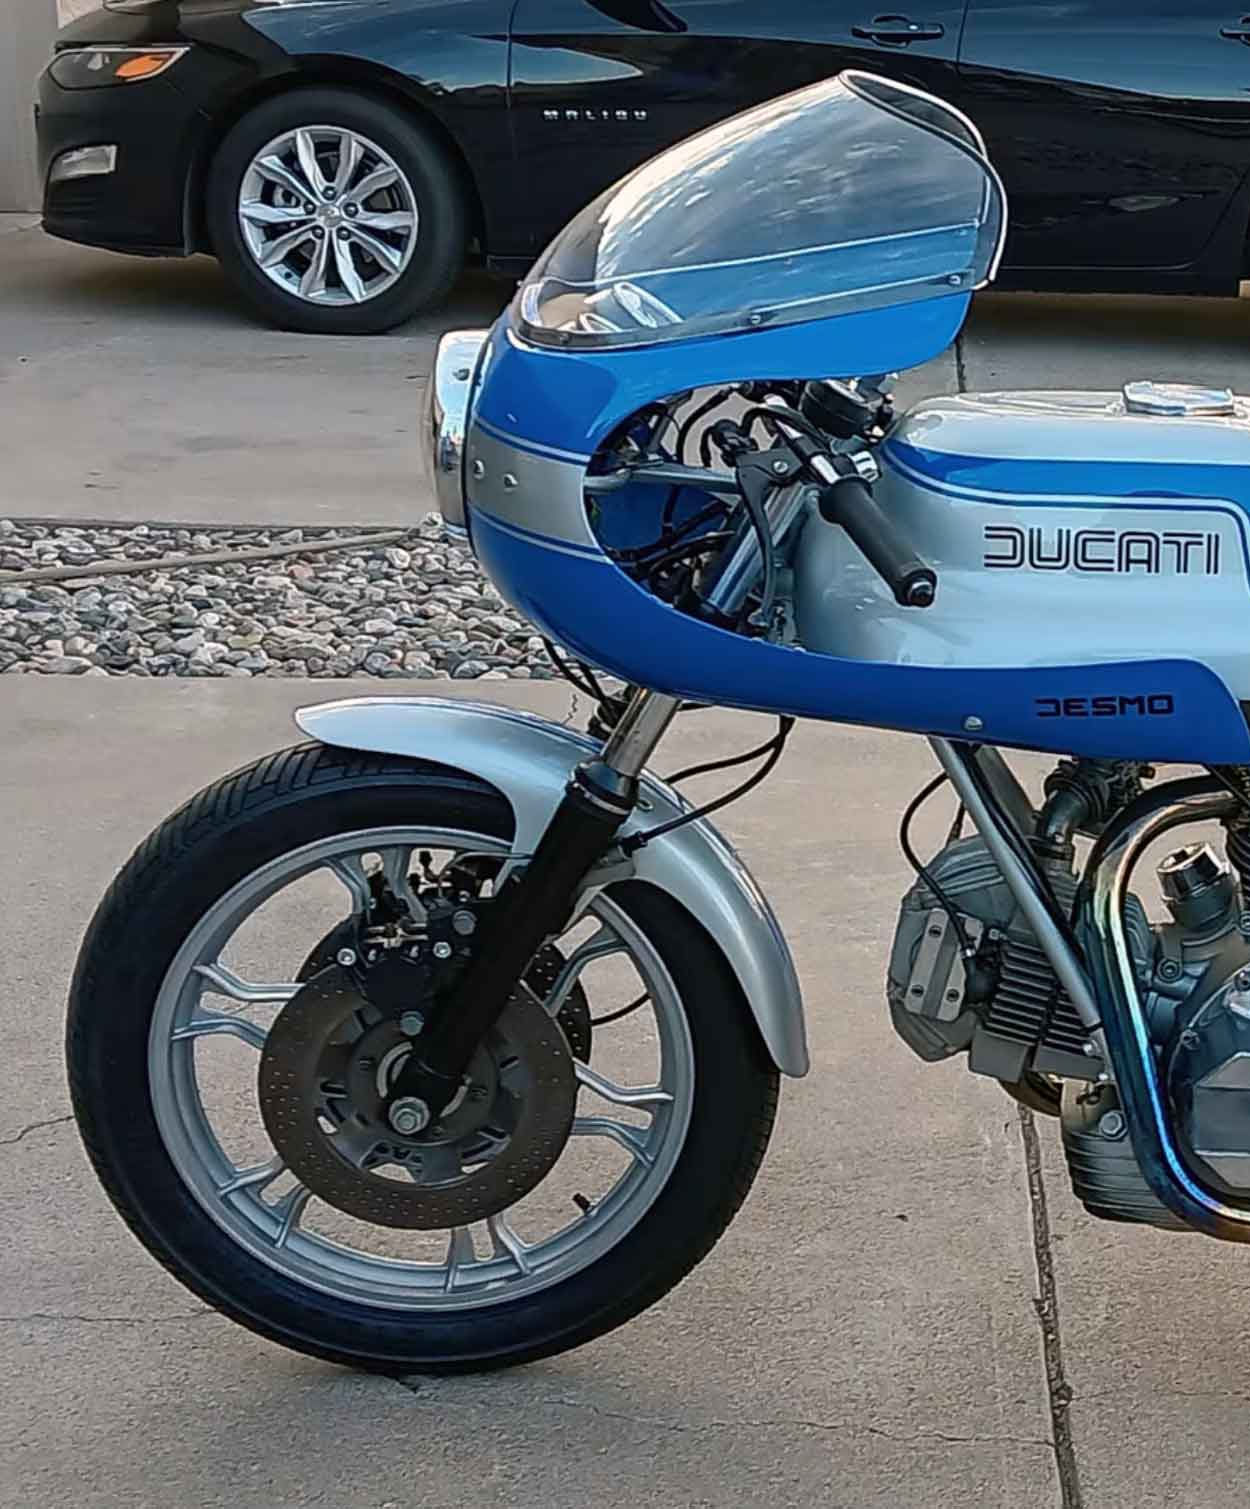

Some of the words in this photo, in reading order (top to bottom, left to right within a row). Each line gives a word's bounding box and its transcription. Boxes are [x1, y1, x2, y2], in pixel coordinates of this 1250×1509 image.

[543, 109, 647, 120] MALIBU
[983, 525, 1220, 575] DUCATI
[1034, 694, 1175, 717] DESMO
